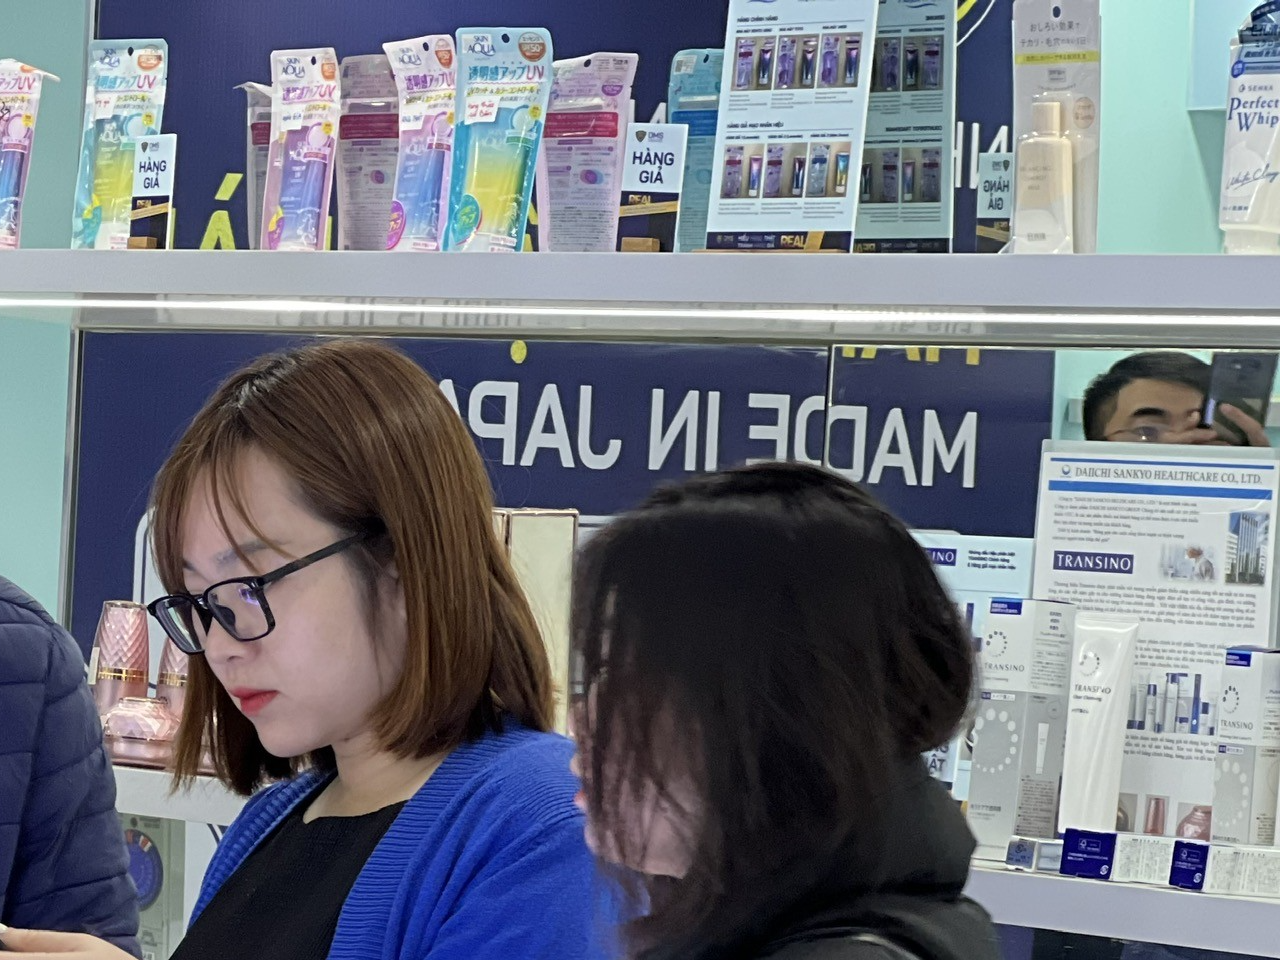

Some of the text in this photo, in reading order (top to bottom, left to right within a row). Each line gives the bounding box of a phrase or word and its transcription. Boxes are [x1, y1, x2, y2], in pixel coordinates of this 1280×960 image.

[473, 36, 488, 44] SKIN
[467, 42, 496, 56] AQUA
[282, 64, 306, 78] AQUA
[1228, 96, 1280, 120] Perfect
[1237, 112, 1280, 132] Whip
[632, 148, 674, 166] HÀNG
[139, 160, 166, 173] HÀNG
[638, 166, 664, 184] GIẢ
[143, 172, 160, 189] GIẢ
[1075, 467, 1111, 479] DAIICHI
[1113, 468, 1152, 480] SANKYO
[1154, 470, 1219, 483] HEALTHCARE
[1241, 473, 1262, 484] LTD.
[1057, 553, 1132, 572] TRANSINO
[984, 662, 1024, 672] TRANSINO
[1220, 720, 1254, 730] TRANSINO
